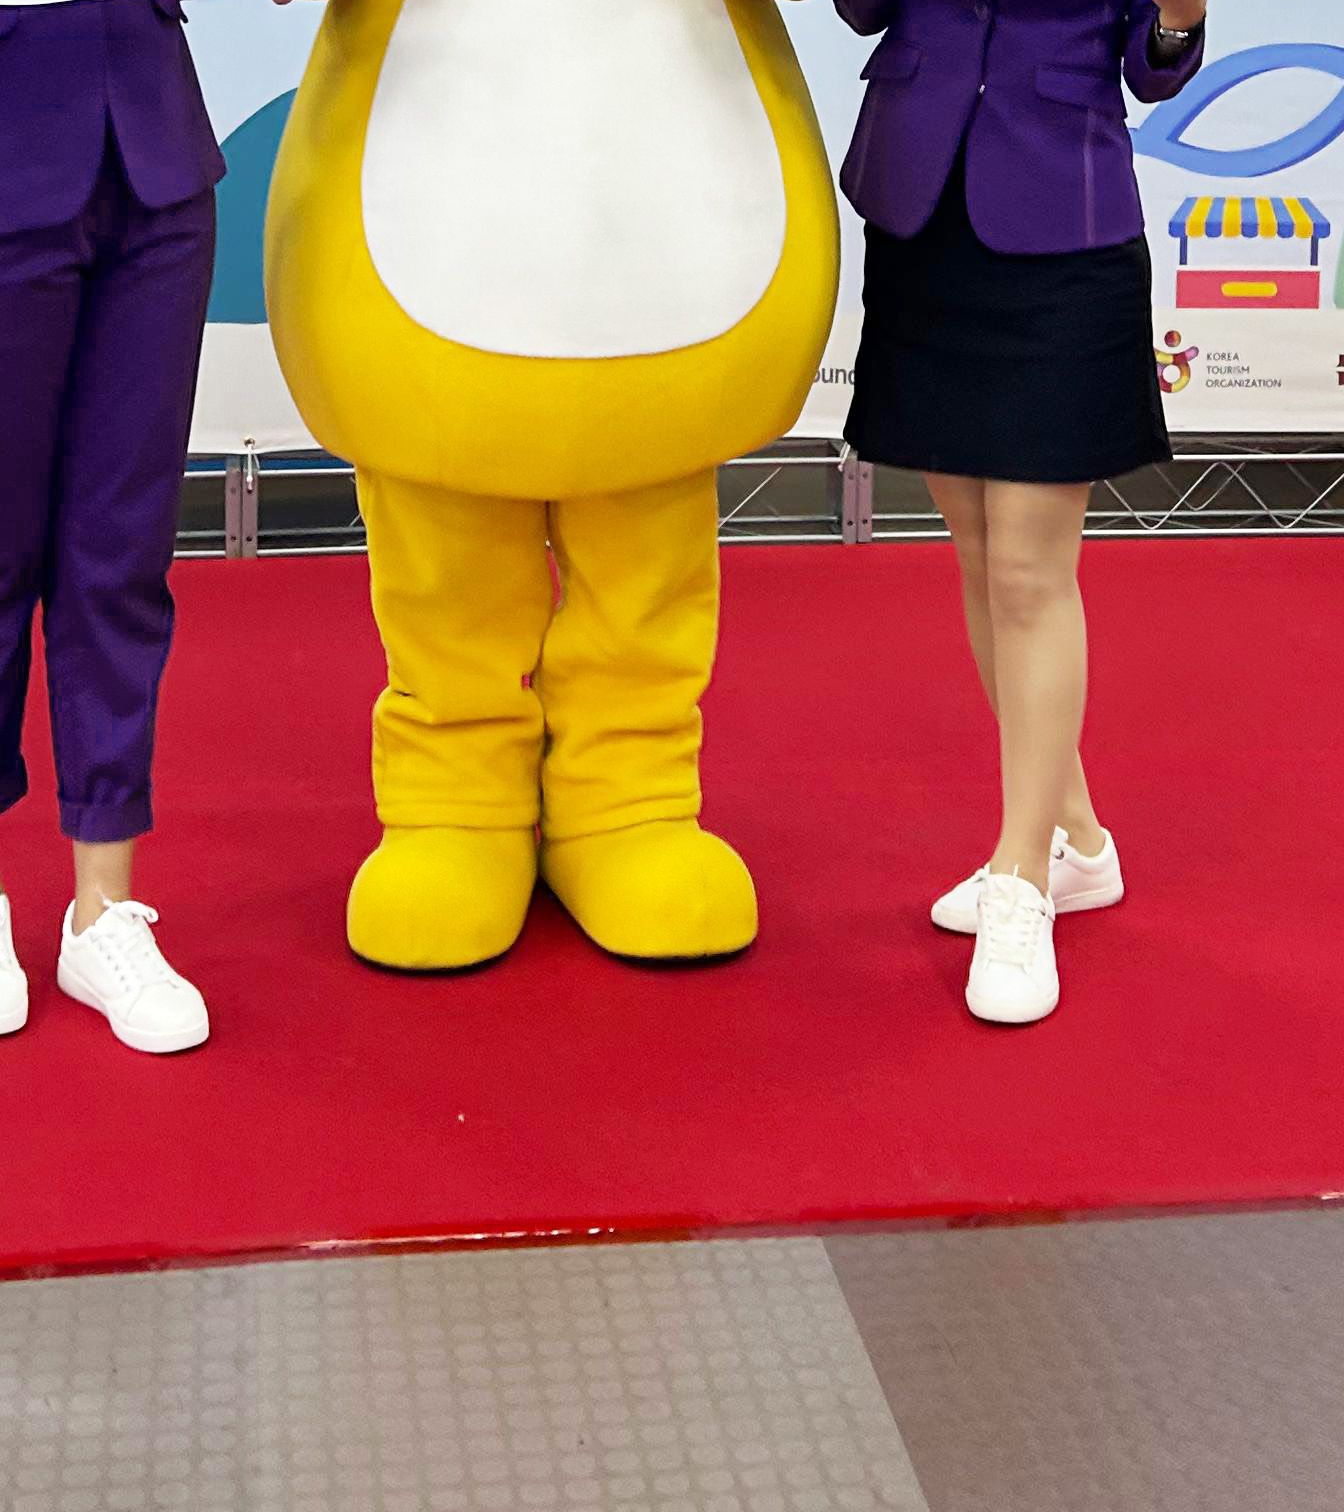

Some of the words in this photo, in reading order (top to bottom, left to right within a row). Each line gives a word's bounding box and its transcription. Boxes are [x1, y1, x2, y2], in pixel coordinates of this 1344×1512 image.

[1206, 352, 1240, 362] KOREA
[1206, 365, 1250, 375] TOURISM
[1206, 378, 1282, 388] ORGANIZATION
